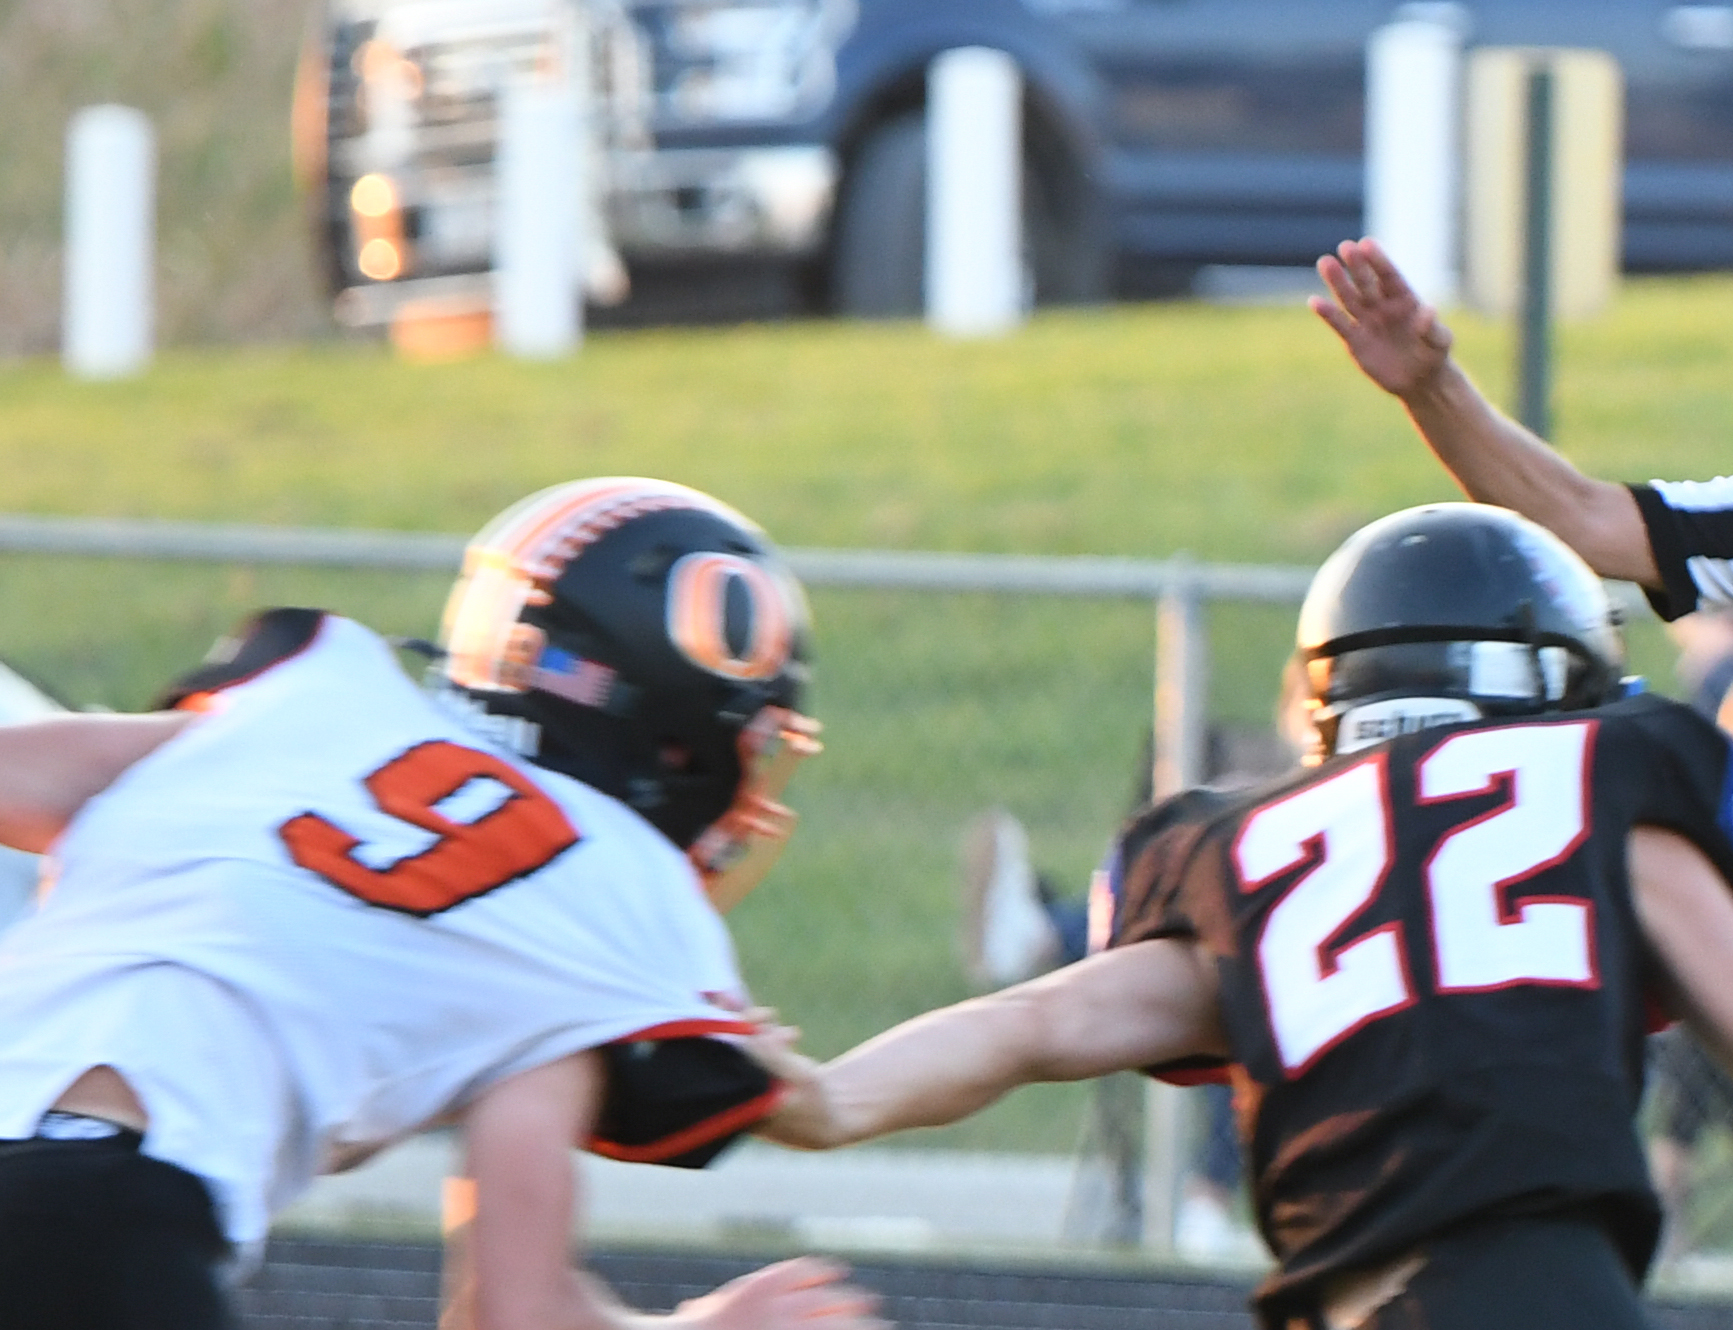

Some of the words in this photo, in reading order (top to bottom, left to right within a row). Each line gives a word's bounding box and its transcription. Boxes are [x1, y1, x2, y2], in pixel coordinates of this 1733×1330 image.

[663, 551, 793, 682] O
[278, 739, 583, 918] 9
[1230, 718, 1601, 1082] 22
